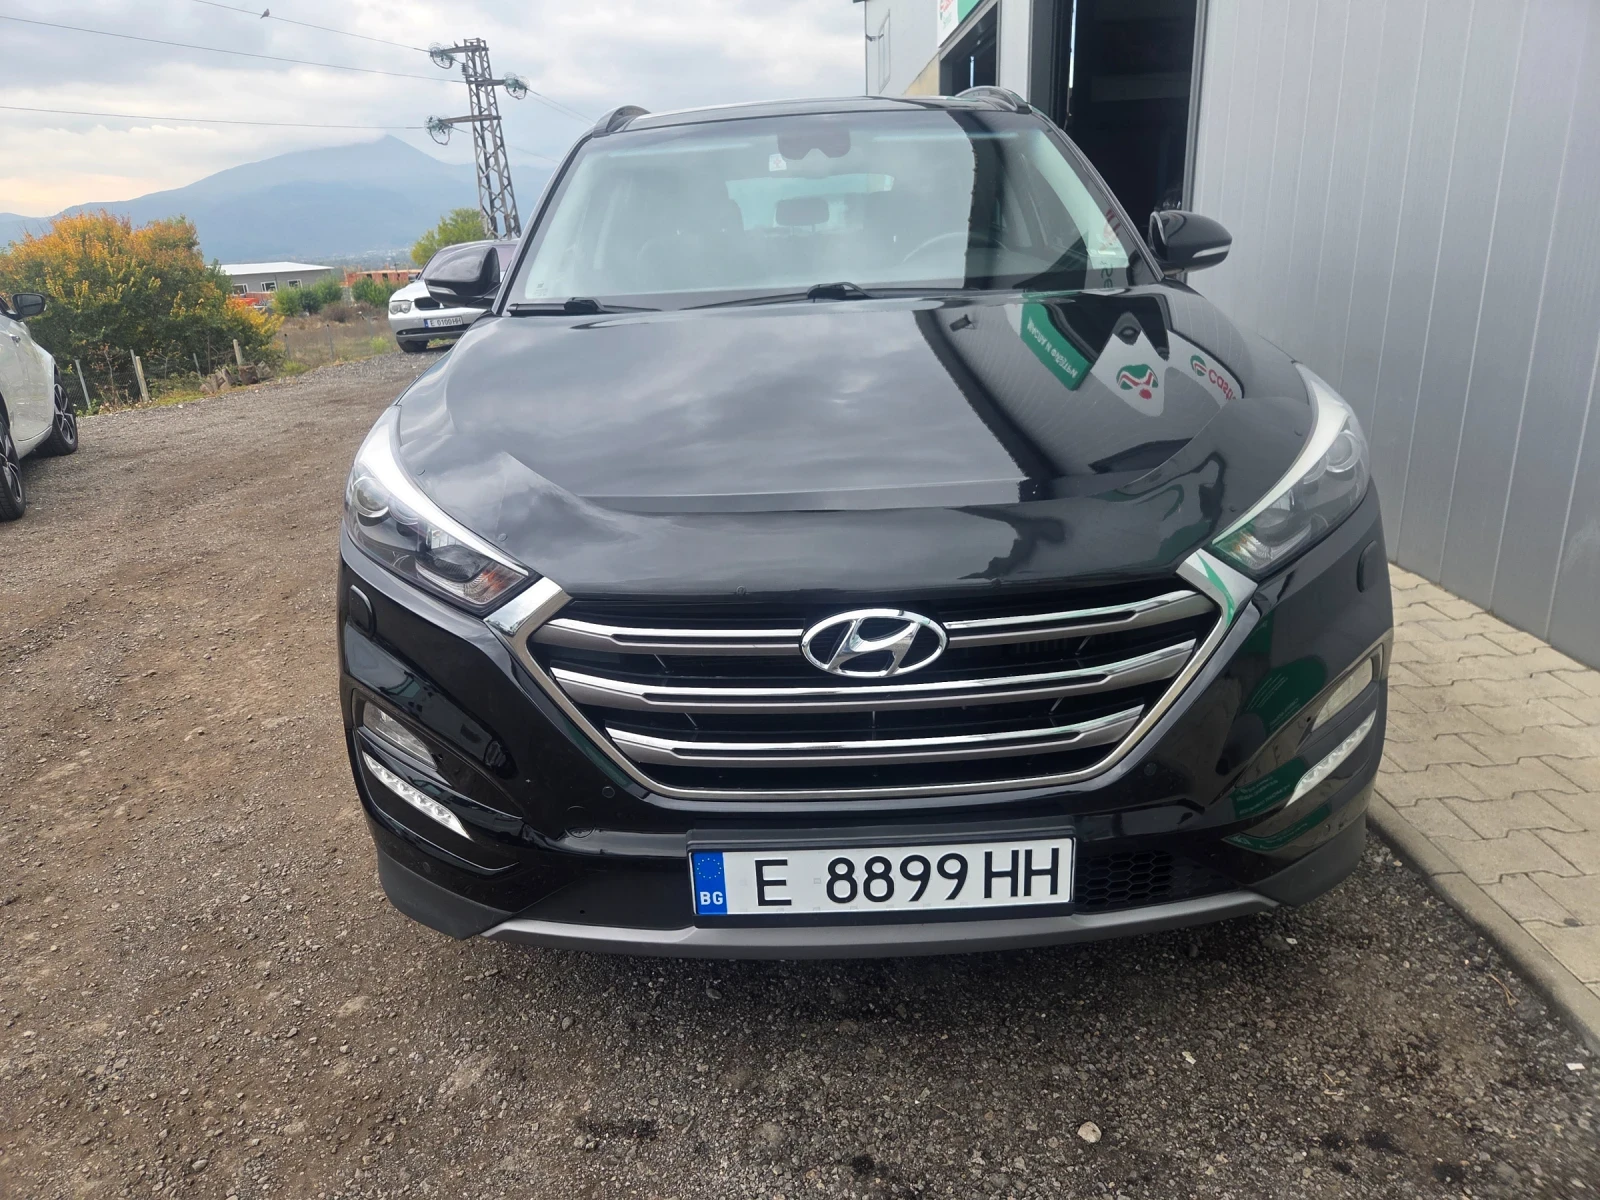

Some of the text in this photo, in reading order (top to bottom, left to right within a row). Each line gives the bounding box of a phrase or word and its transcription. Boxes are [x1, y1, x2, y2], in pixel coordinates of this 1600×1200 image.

[754, 846, 1060, 907] E 8899 HH
[699, 890, 724, 905] BG
